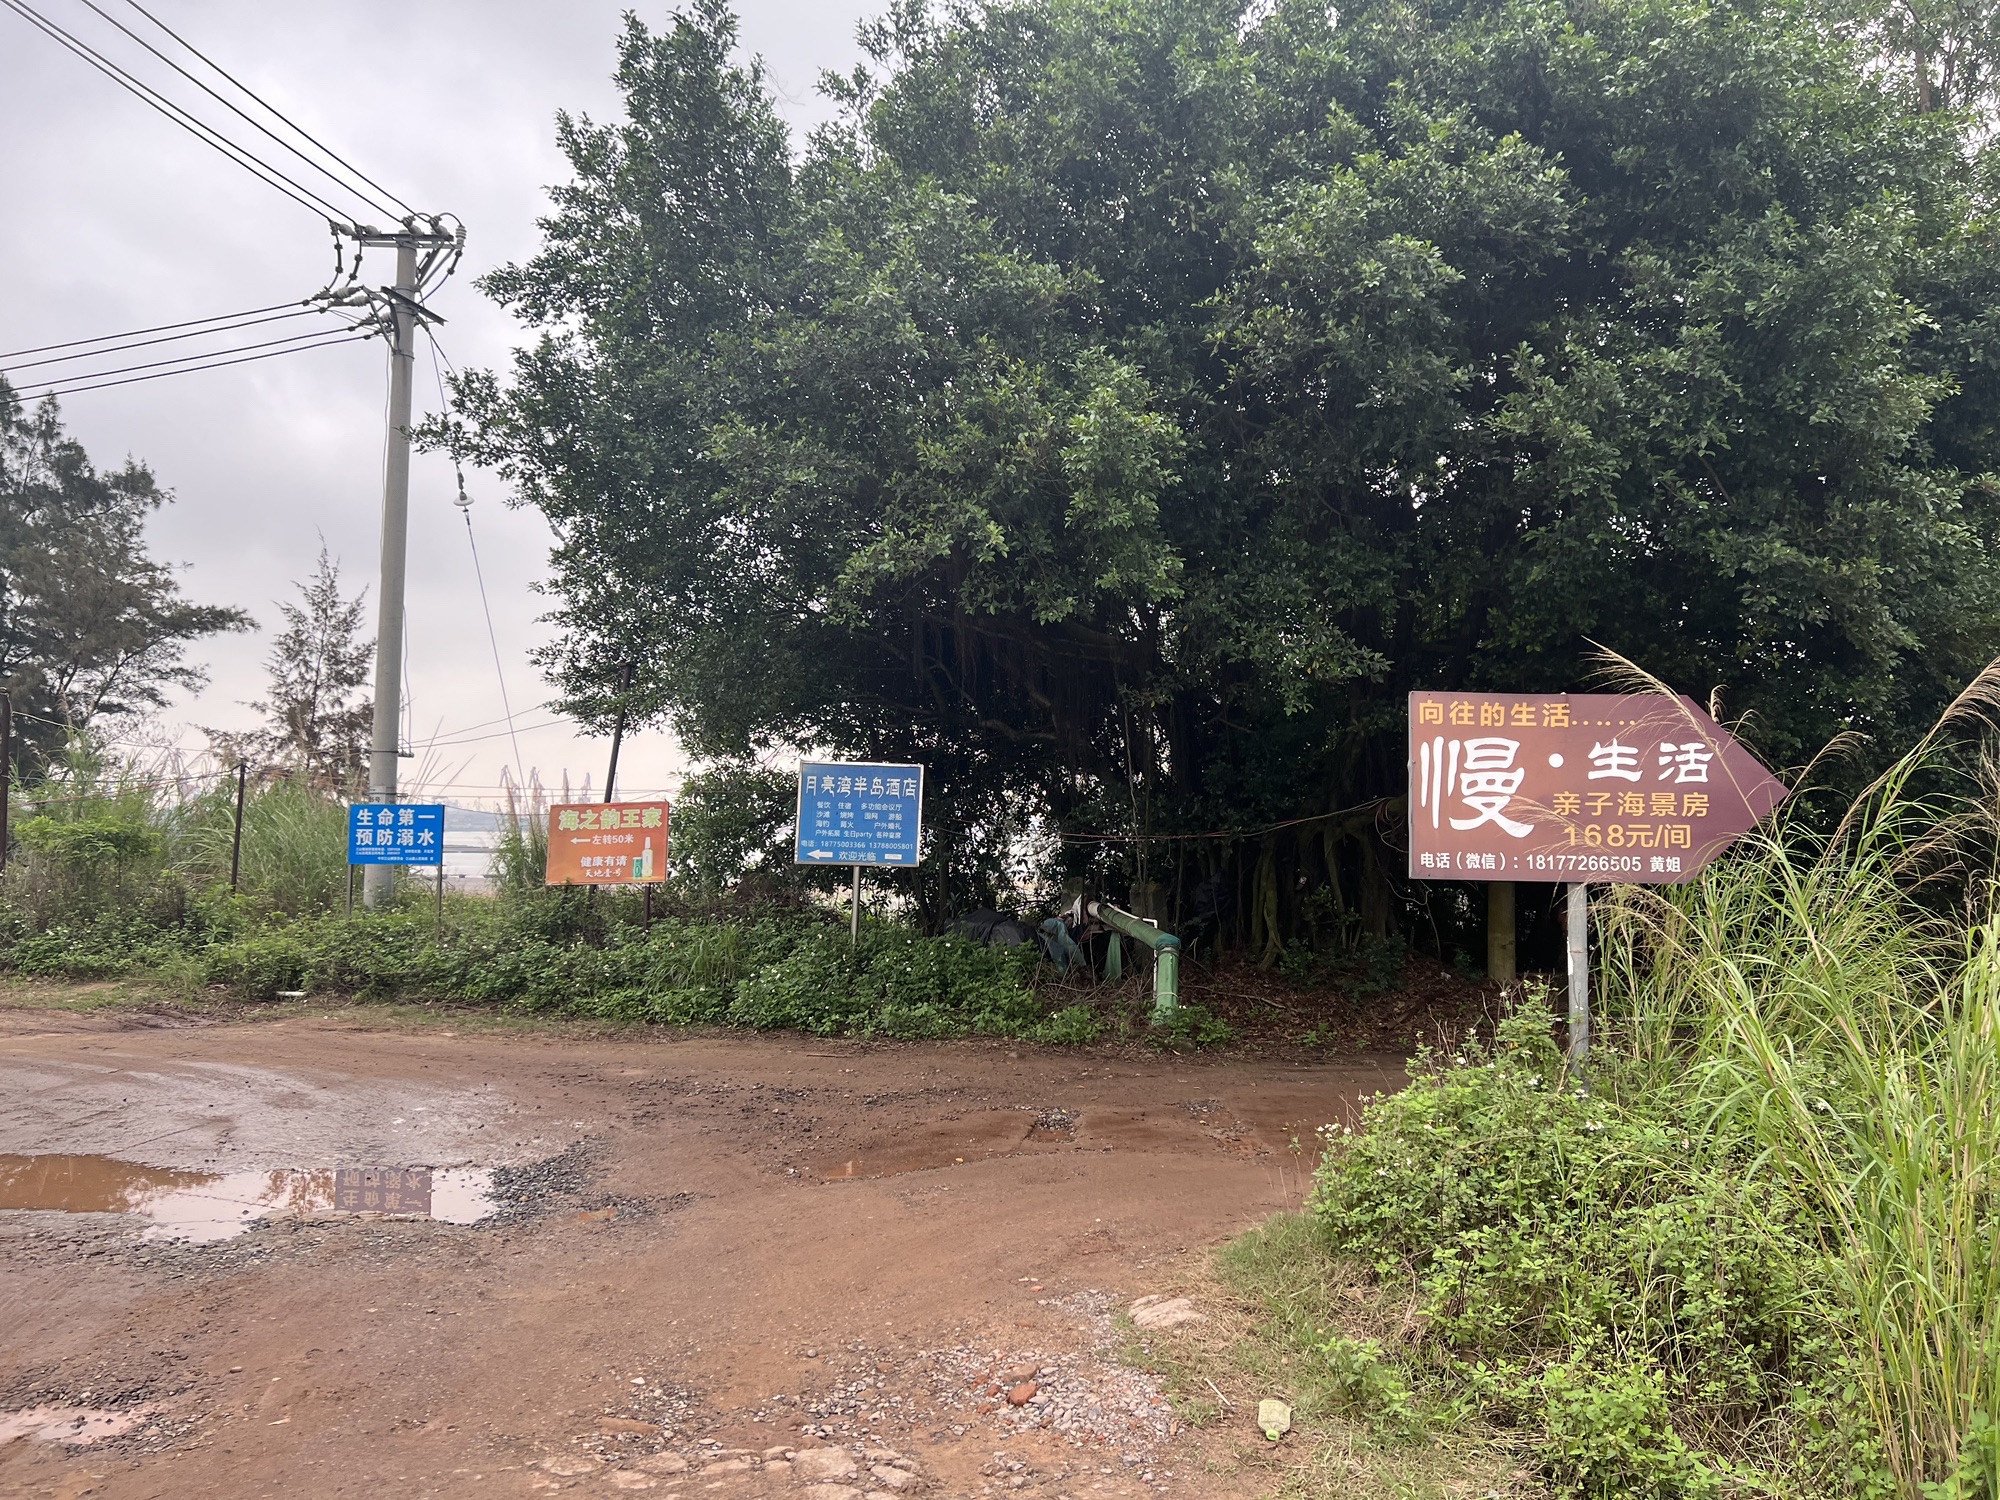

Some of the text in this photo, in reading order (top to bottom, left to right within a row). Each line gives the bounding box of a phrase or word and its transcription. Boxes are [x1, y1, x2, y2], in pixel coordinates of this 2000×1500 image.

[805, 775, 917, 800] 月亮湾半岛酒店
[816, 801, 902, 811] 餐饮 住宿 多功能会议厅
[1552, 791, 1710, 817] 亲子海景房
[356, 808, 436, 827] 生命第一
[558, 807, 663, 831] 海之韵王家
[816, 810, 830, 818] 沙滩
[839, 811, 854, 819] 烧烤
[873, 822, 902, 830] 户外婚礼
[355, 828, 435, 847] 预防溺水
[592, 833, 635, 845] 左转50米
[814, 829, 840, 837] 户外拓展
[843, 830, 873, 839] 生日party
[1563, 823, 1692, 849] 168元/间
[821, 840, 866, 849] 18775003366
[869, 842, 913, 850] 13788005801
[580, 855, 628, 868] 健康有请
[838, 851, 877, 862] 欢迎光临
[1650, 856, 1682, 873] 黄姐
